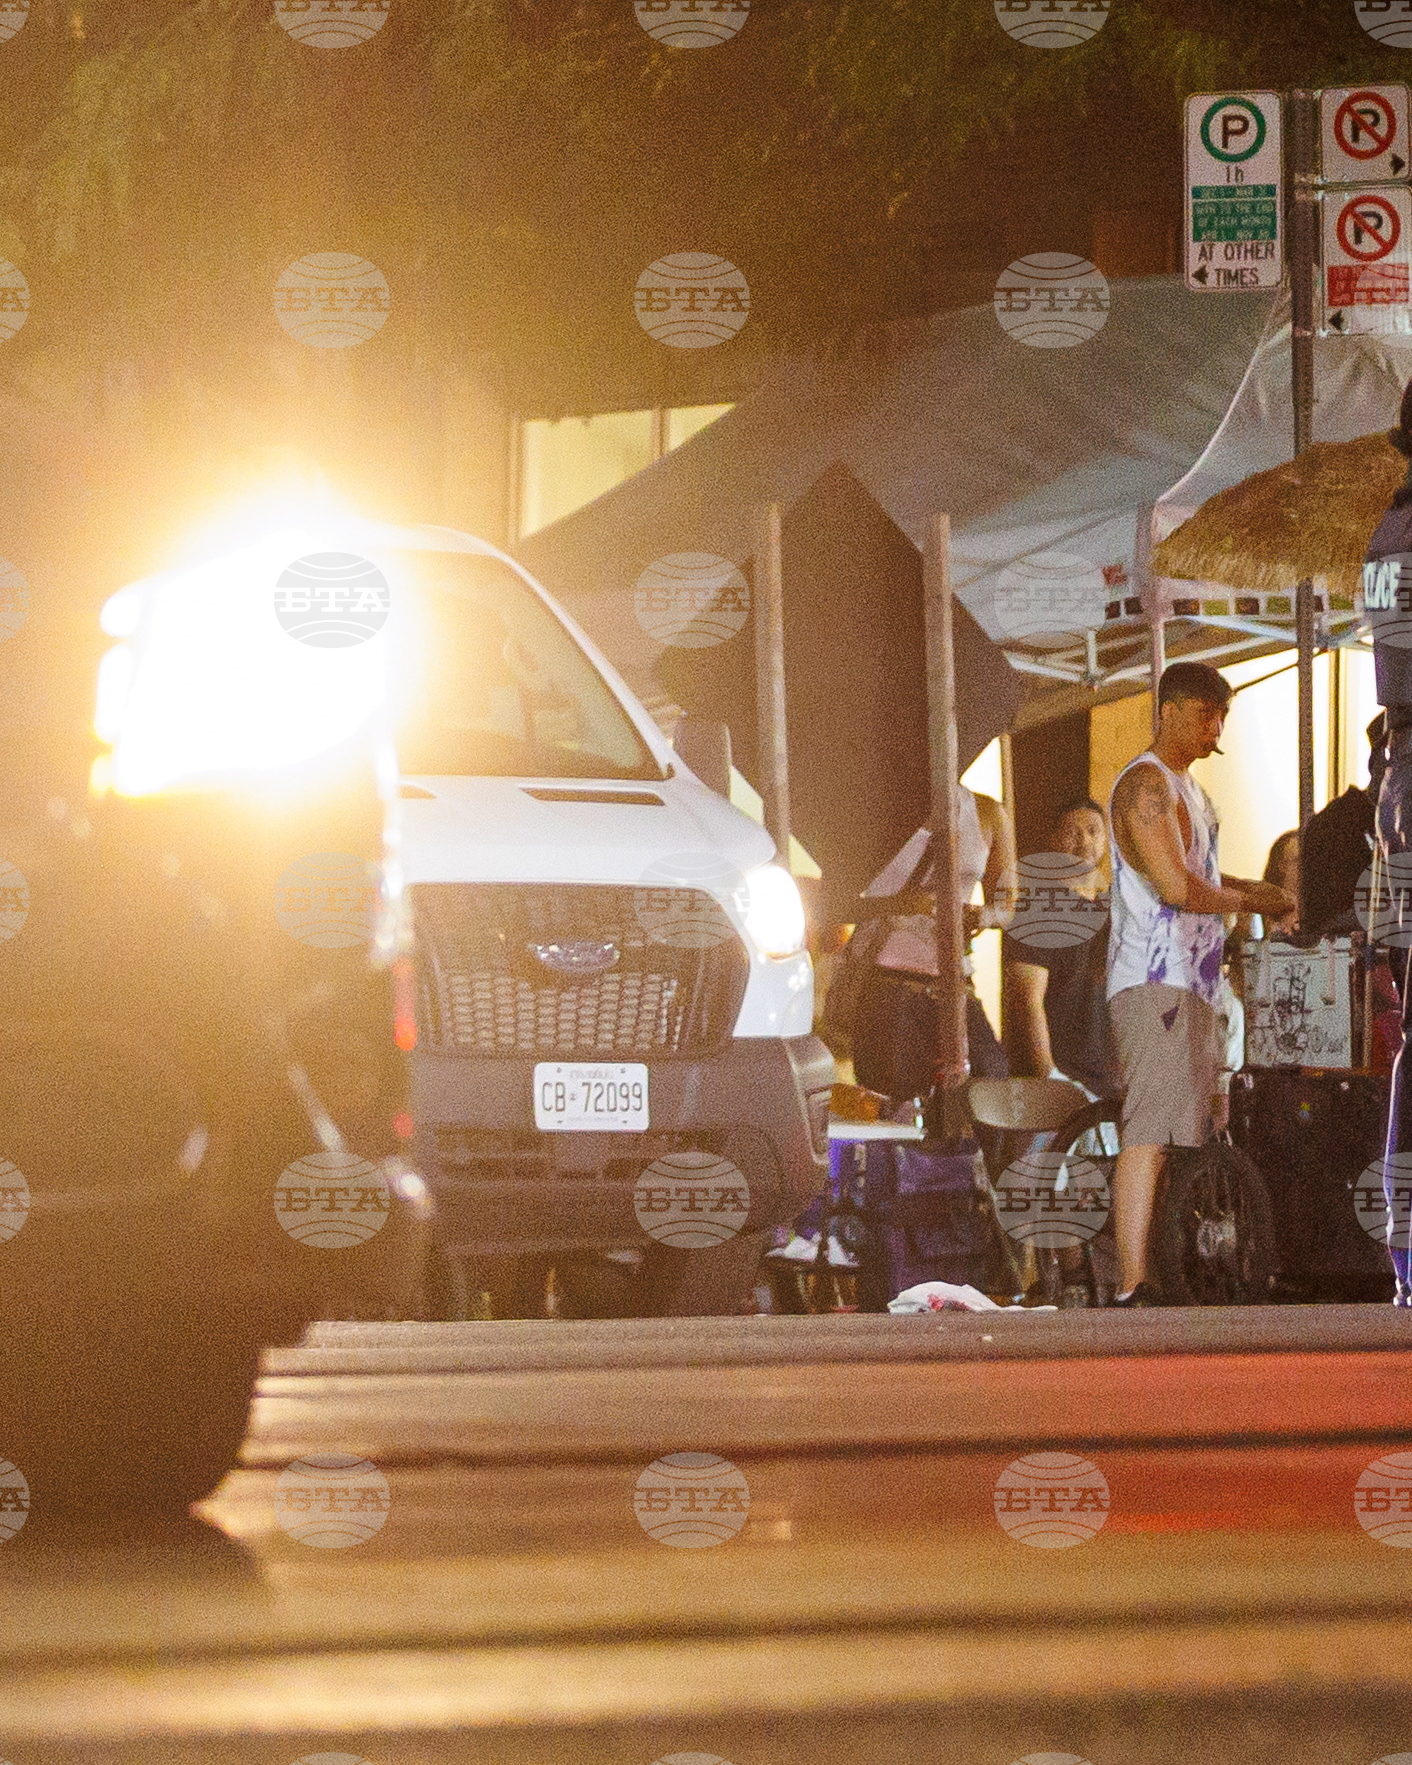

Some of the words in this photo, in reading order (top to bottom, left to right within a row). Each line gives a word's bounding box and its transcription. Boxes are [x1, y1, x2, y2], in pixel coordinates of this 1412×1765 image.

[1222, 114, 1249, 149] P
[1224, 242, 1276, 262] OTHER
[1214, 267, 1260, 286] TIMES
[541, 1081, 566, 1112] CB
[581, 1081, 643, 1112] 72099
